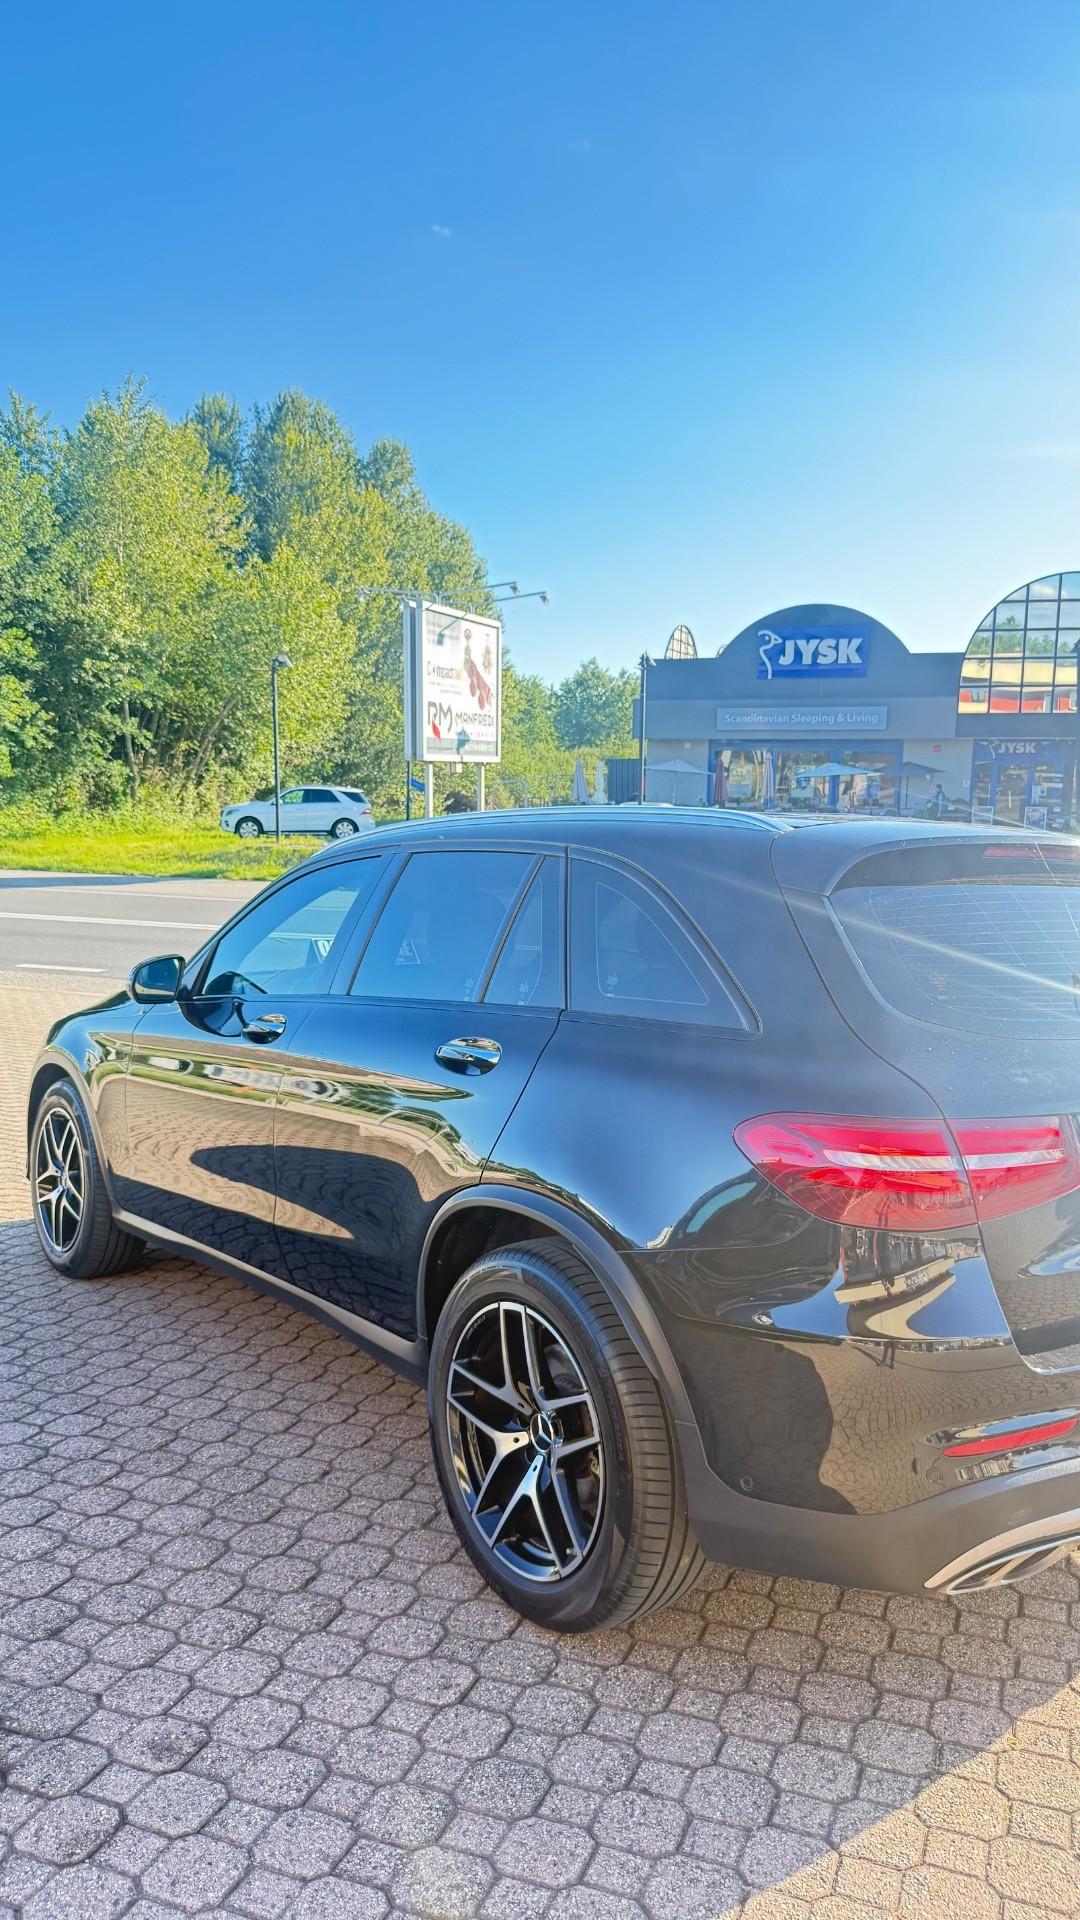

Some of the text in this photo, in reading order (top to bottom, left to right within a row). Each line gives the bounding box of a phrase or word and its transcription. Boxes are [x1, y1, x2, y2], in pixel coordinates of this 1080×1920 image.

[778, 638, 863, 665] JYSK
[724, 713, 879, 725] Scandinavian Sleeping & Living
[998, 742, 1037, 754] JYSK
